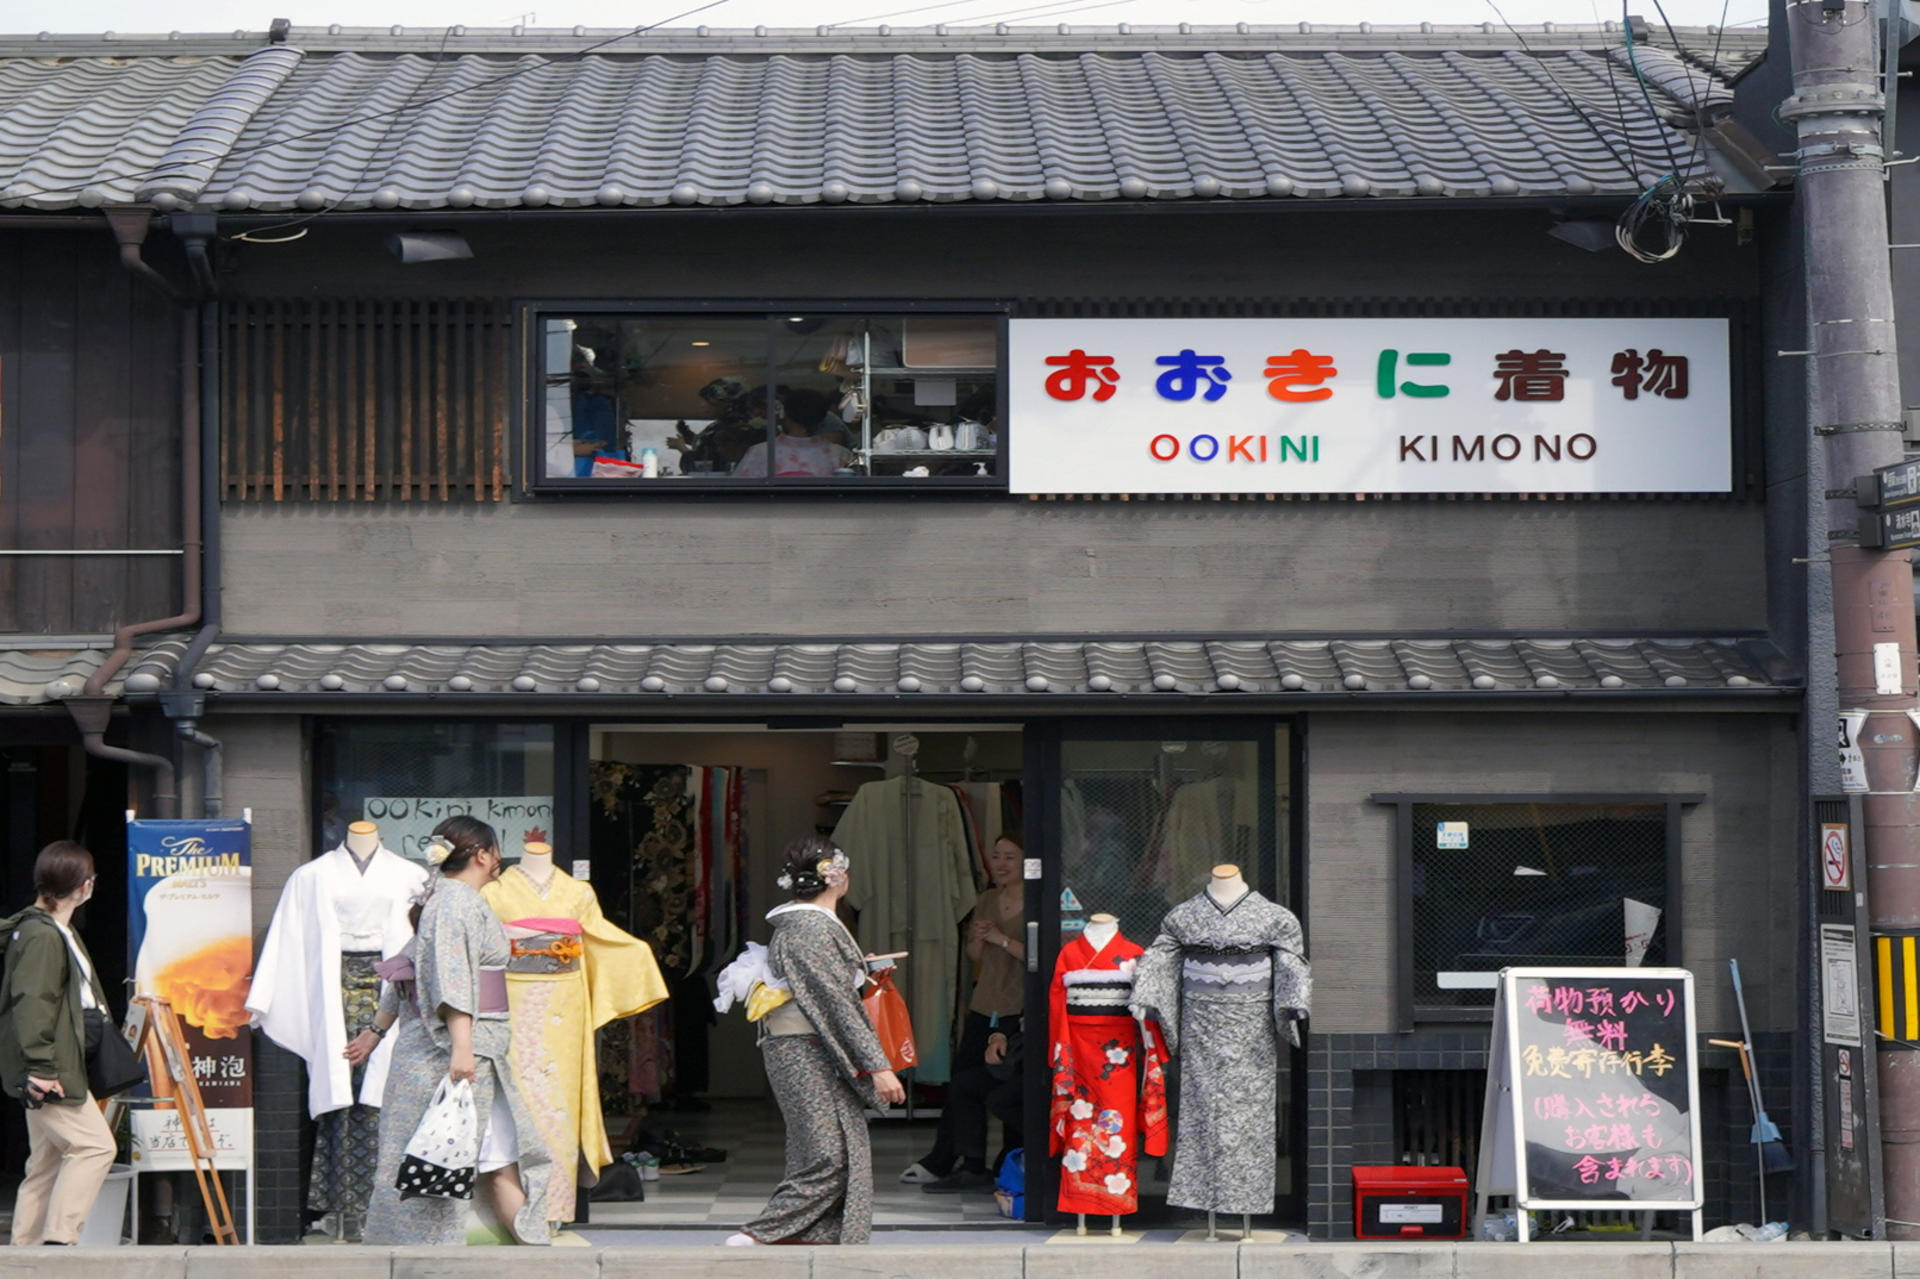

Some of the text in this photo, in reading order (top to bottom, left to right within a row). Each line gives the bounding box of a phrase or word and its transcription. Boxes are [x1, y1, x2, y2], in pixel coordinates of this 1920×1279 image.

[1045, 349, 1690, 402] おおきに着物
[1149, 434, 1598, 463] OOKINI KIMONO
[161, 836, 213, 856] The
[136, 853, 240, 877] PREMIUM
[1563, 1018, 1629, 1050] 無料
[192, 1055, 246, 1079] 神泡
